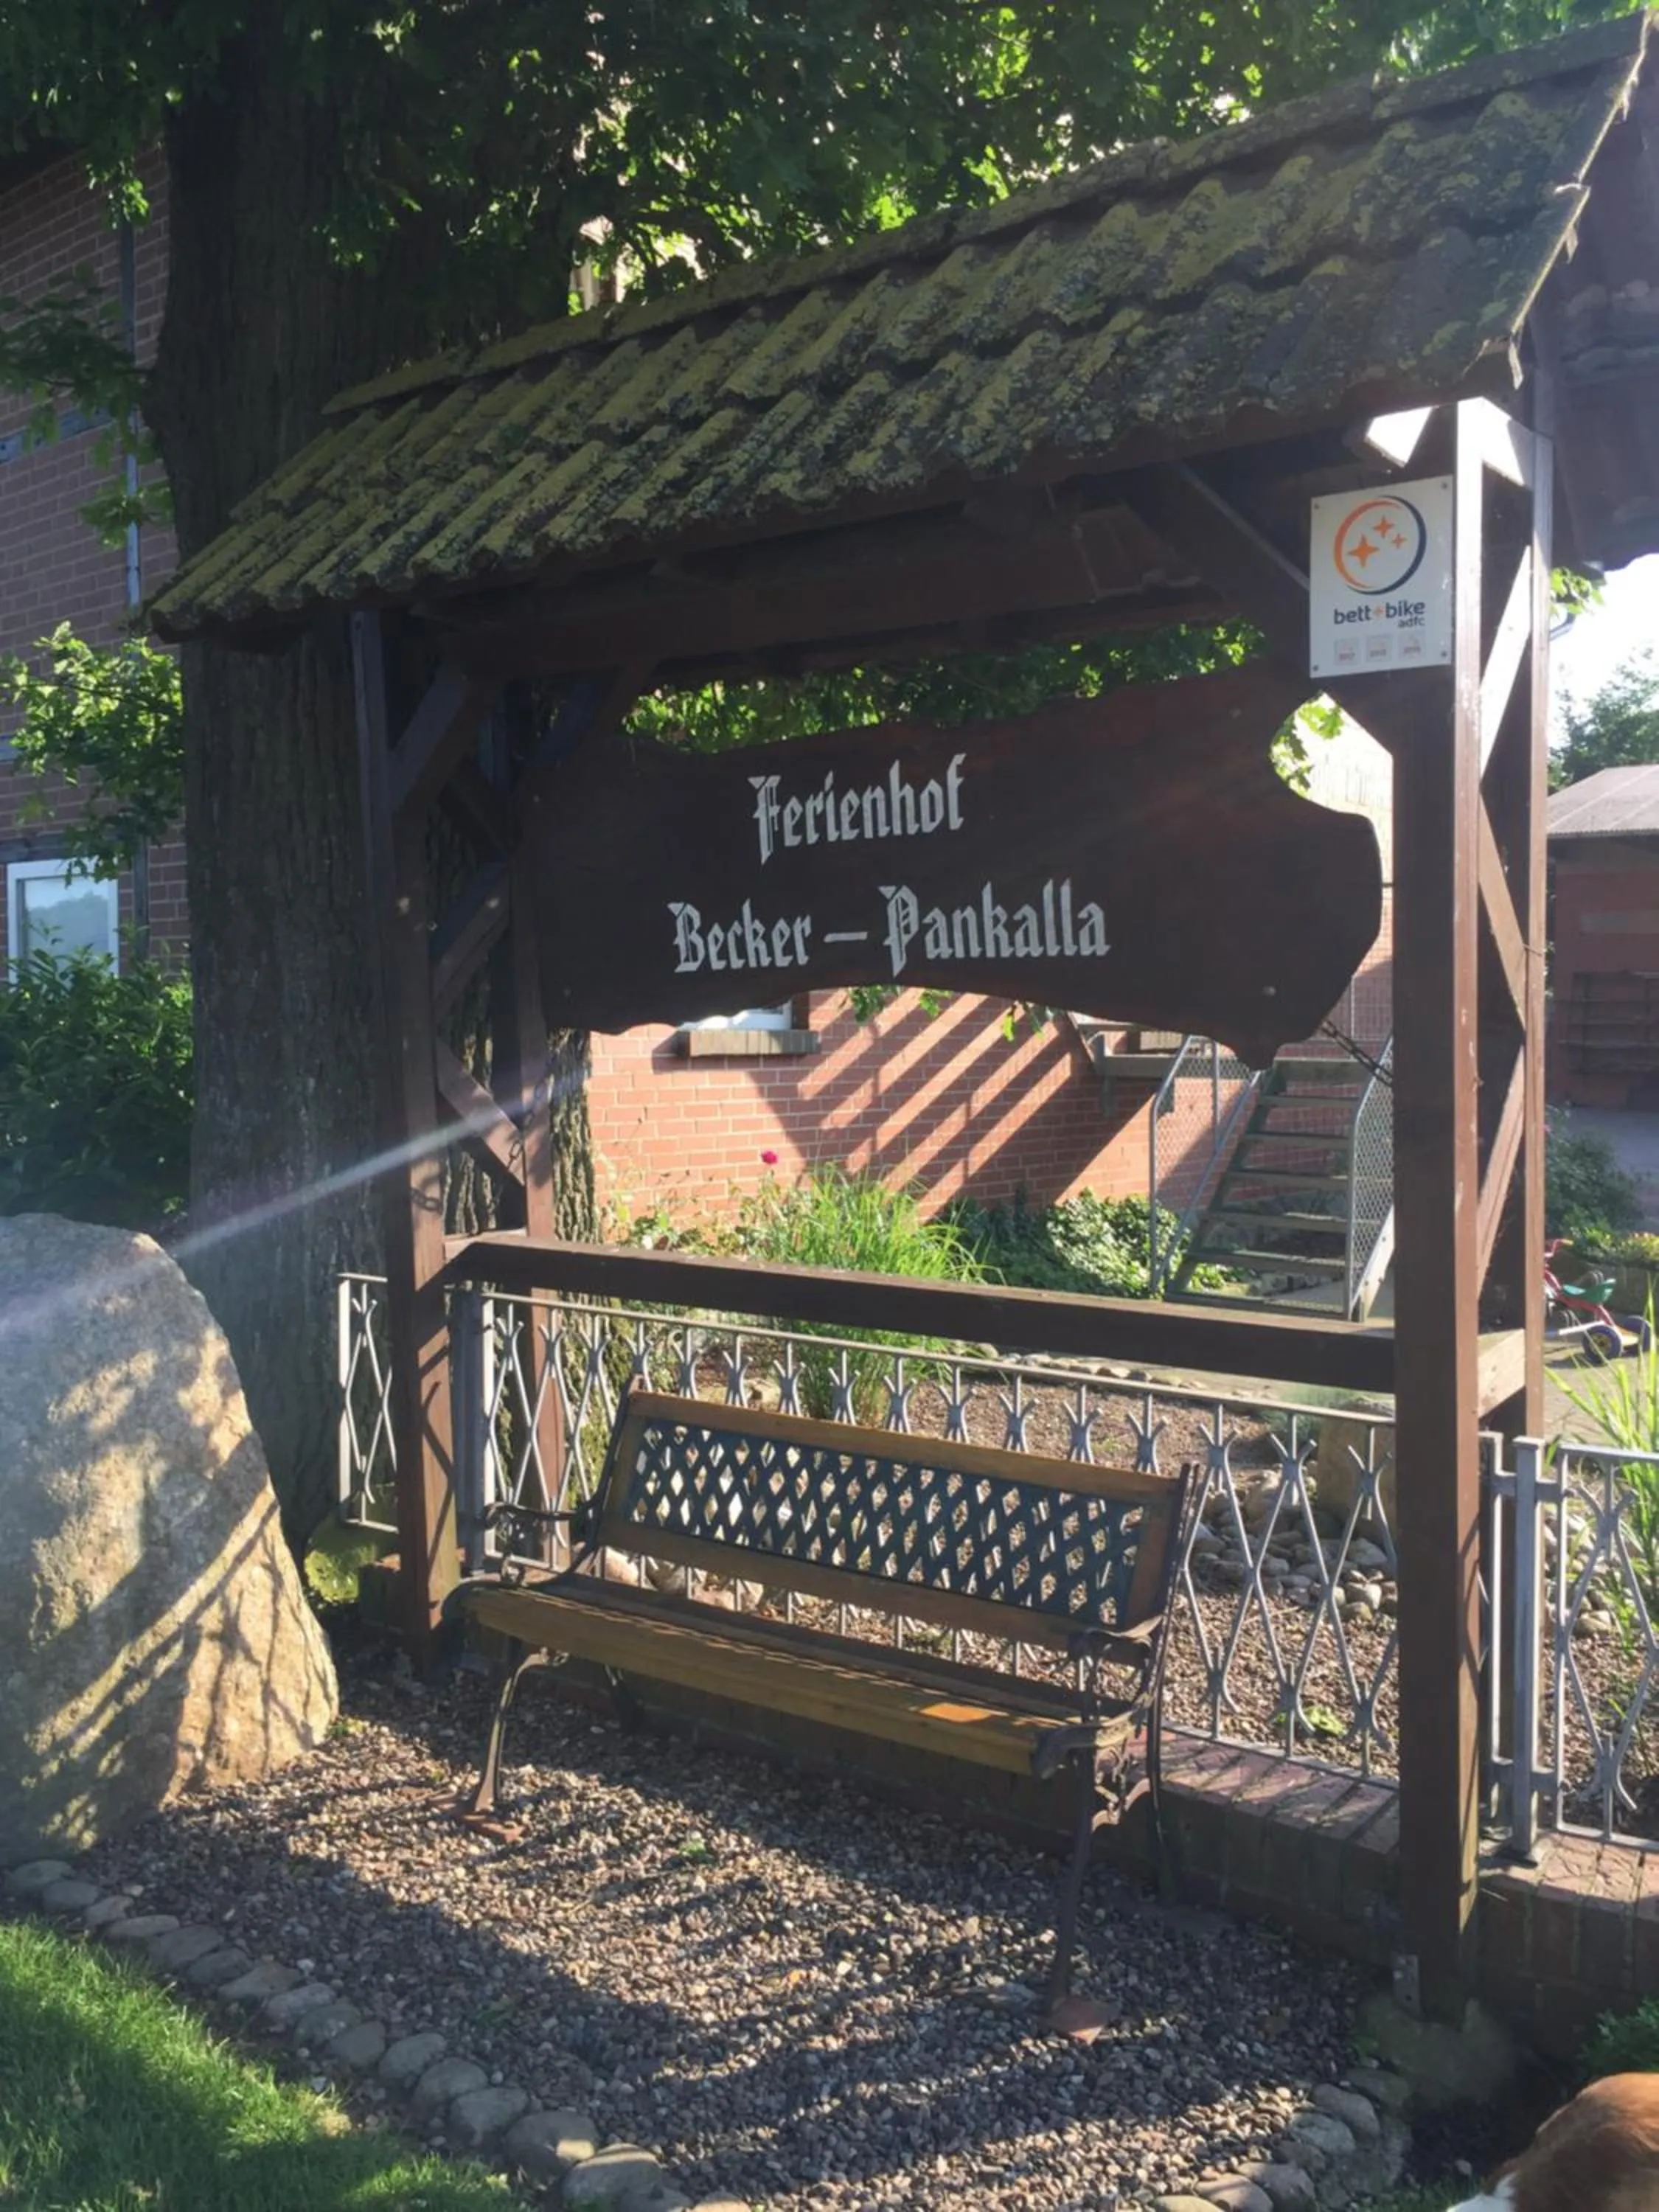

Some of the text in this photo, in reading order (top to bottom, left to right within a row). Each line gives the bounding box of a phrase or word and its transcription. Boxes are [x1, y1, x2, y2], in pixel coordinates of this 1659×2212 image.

[1398, 616, 1425, 628] adfc
[748, 754, 966, 864] Ferienhof
[667, 898, 811, 973] Becker
[879, 879, 1111, 978] Pankalla
